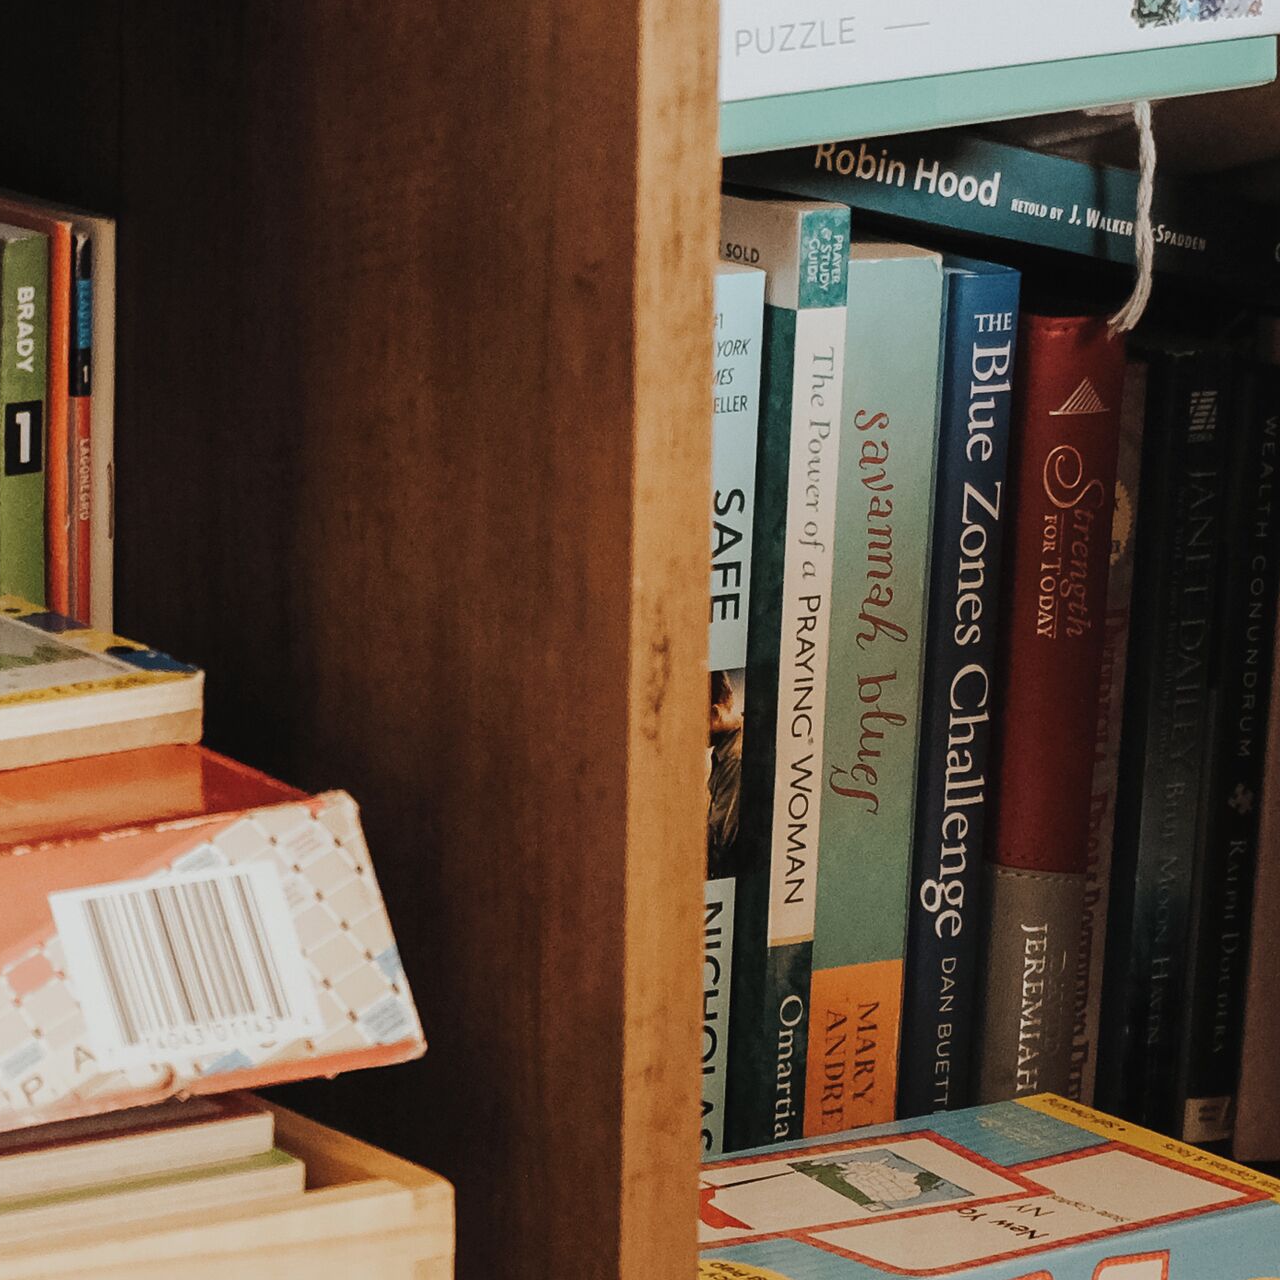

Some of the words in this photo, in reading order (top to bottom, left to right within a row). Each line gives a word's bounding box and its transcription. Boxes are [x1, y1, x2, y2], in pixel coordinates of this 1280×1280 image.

[734, 16, 856, 57] PUZZLE
[814, 140, 905, 188] Robin
[914, 157, 1002, 208] Hood
[1010, 198, 1048, 218] RETOLD
[1049, 206, 1064, 221] BY
[1068, 204, 1082, 225] J.
[725, 242, 760, 263] SOLD
[806, 238, 821, 284] GUIDE
[818, 244, 834, 292] STUDY
[831, 233, 845, 285] PRAYER
[15, 285, 36, 374] BRADY
[716, 337, 752, 358] YORK
[973, 311, 1013, 334] THE
[809, 345, 835, 408] The
[965, 339, 1012, 462] Blue
[15, 410, 32, 465] 1
[804, 419, 832, 513] Power
[1252, 416, 1280, 538] WEALTH
[709, 487, 746, 624] SAFE
[798, 520, 825, 553] of
[801, 559, 818, 581] a
[953, 480, 1003, 647] Zones
[1042, 513, 1058, 553] FOR
[1043, 444, 1105, 638] Strength
[1036, 556, 1062, 639] TODAY
[790, 594, 822, 738] PRAYING
[1236, 555, 1267, 759] CONUNDRUM
[828, 669, 908, 816] blues
[783, 753, 815, 905] WOMAN
[919, 663, 992, 939] Challenge
[939, 956, 958, 1014] DAN
[1015, 922, 1049, 1093] JEREMIAH
[852, 1001, 881, 1103] MARY
[991, 1217, 1051, 1241] New
[1006, 1203, 1056, 1219] NY
